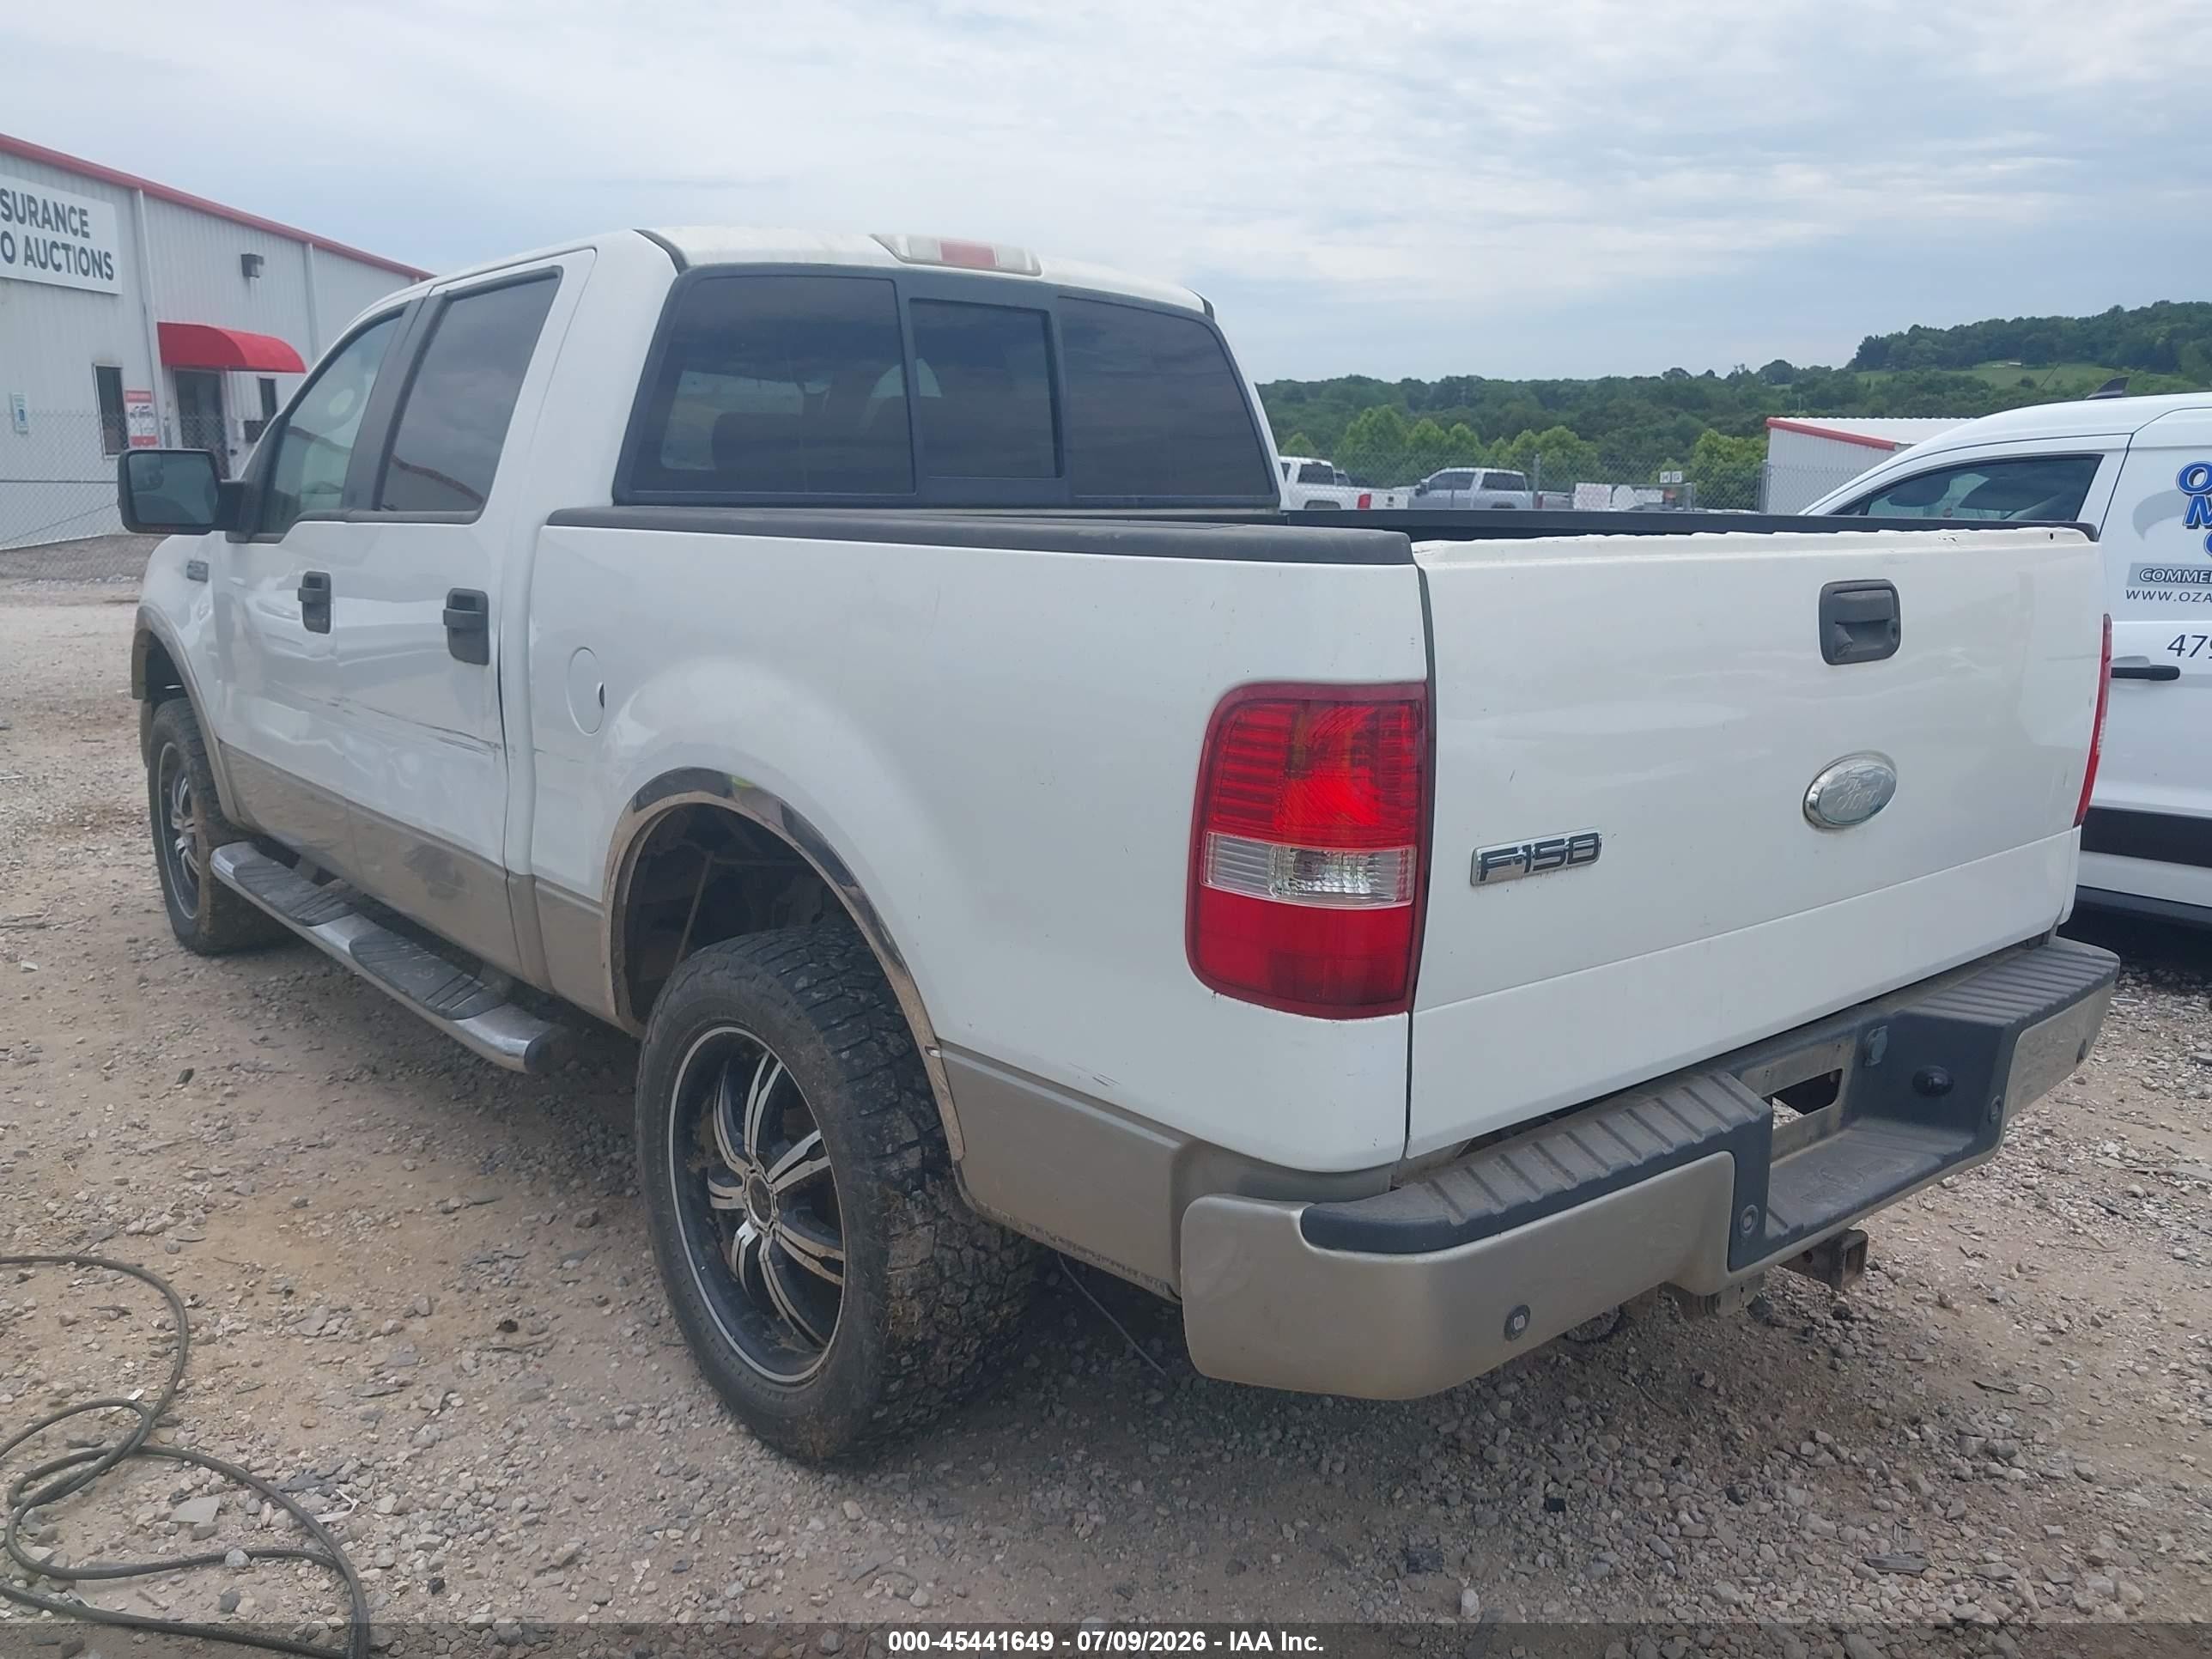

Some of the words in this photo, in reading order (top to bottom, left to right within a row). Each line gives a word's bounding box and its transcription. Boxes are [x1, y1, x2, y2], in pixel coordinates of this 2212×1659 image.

[0, 188, 90, 240] SURANCE
[0, 230, 16, 264] O
[24, 234, 114, 281] AUCTIONS
[2140, 568, 2212, 584] COMME
[2166, 634, 2212, 659] 47
